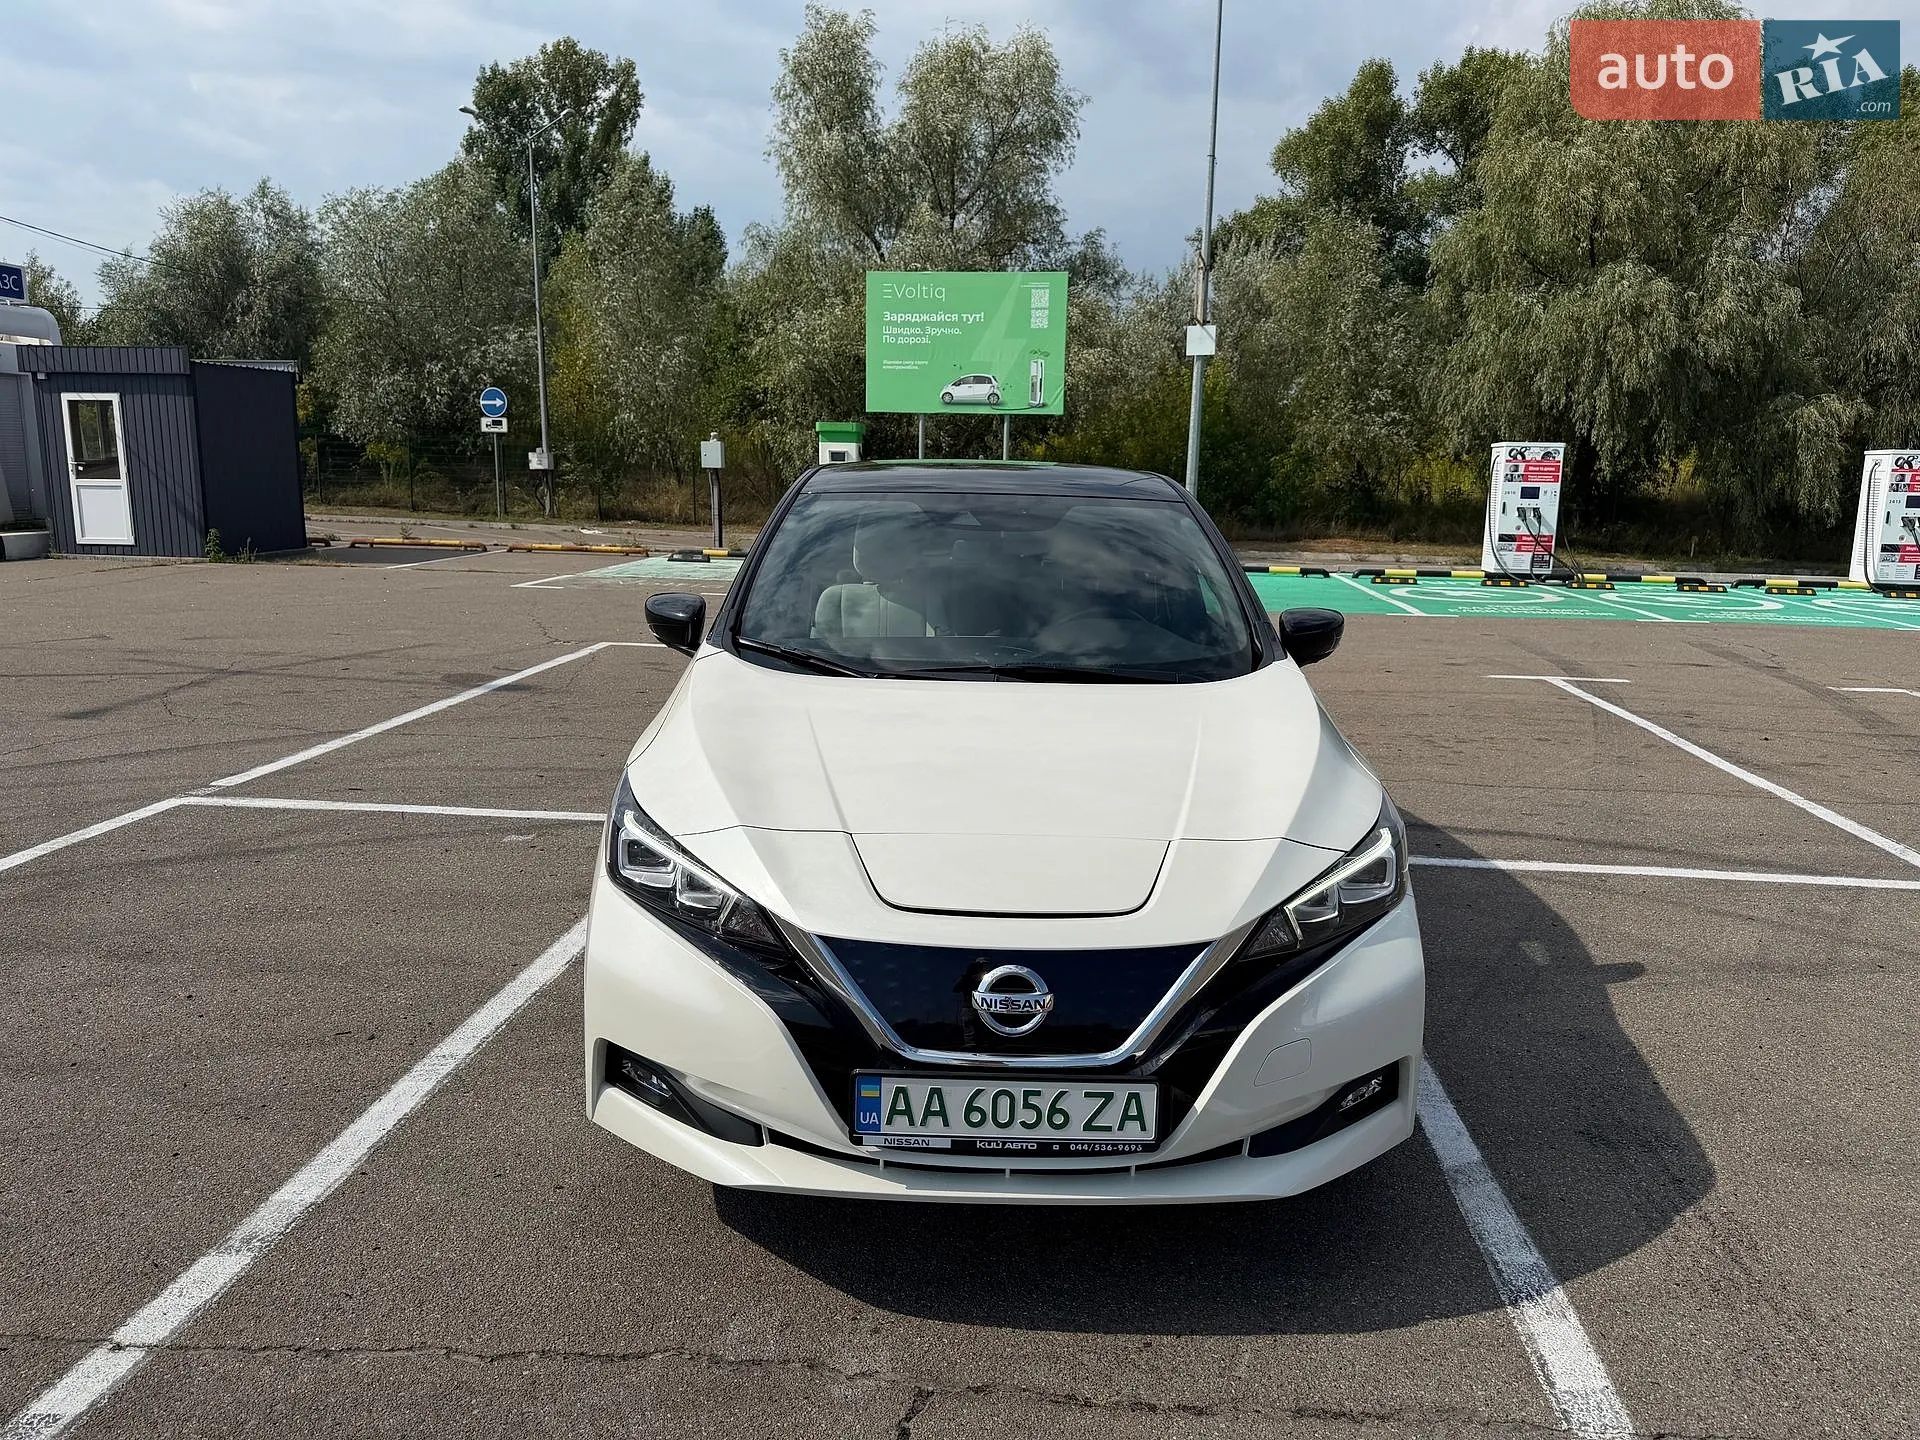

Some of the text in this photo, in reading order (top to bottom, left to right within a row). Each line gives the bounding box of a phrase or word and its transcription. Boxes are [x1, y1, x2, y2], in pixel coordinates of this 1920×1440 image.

[883, 311, 985, 324] Заряджайся тут!
[882, 325, 962, 336] Швидко. Зручно.
[882, 335, 931, 345] По дорозі.
[980, 996, 1046, 1011] NISSAN
[884, 1085, 1147, 1132] AA 6056 ZA
[859, 1111, 880, 1125] UA
[883, 1137, 930, 1147] NISSAN
